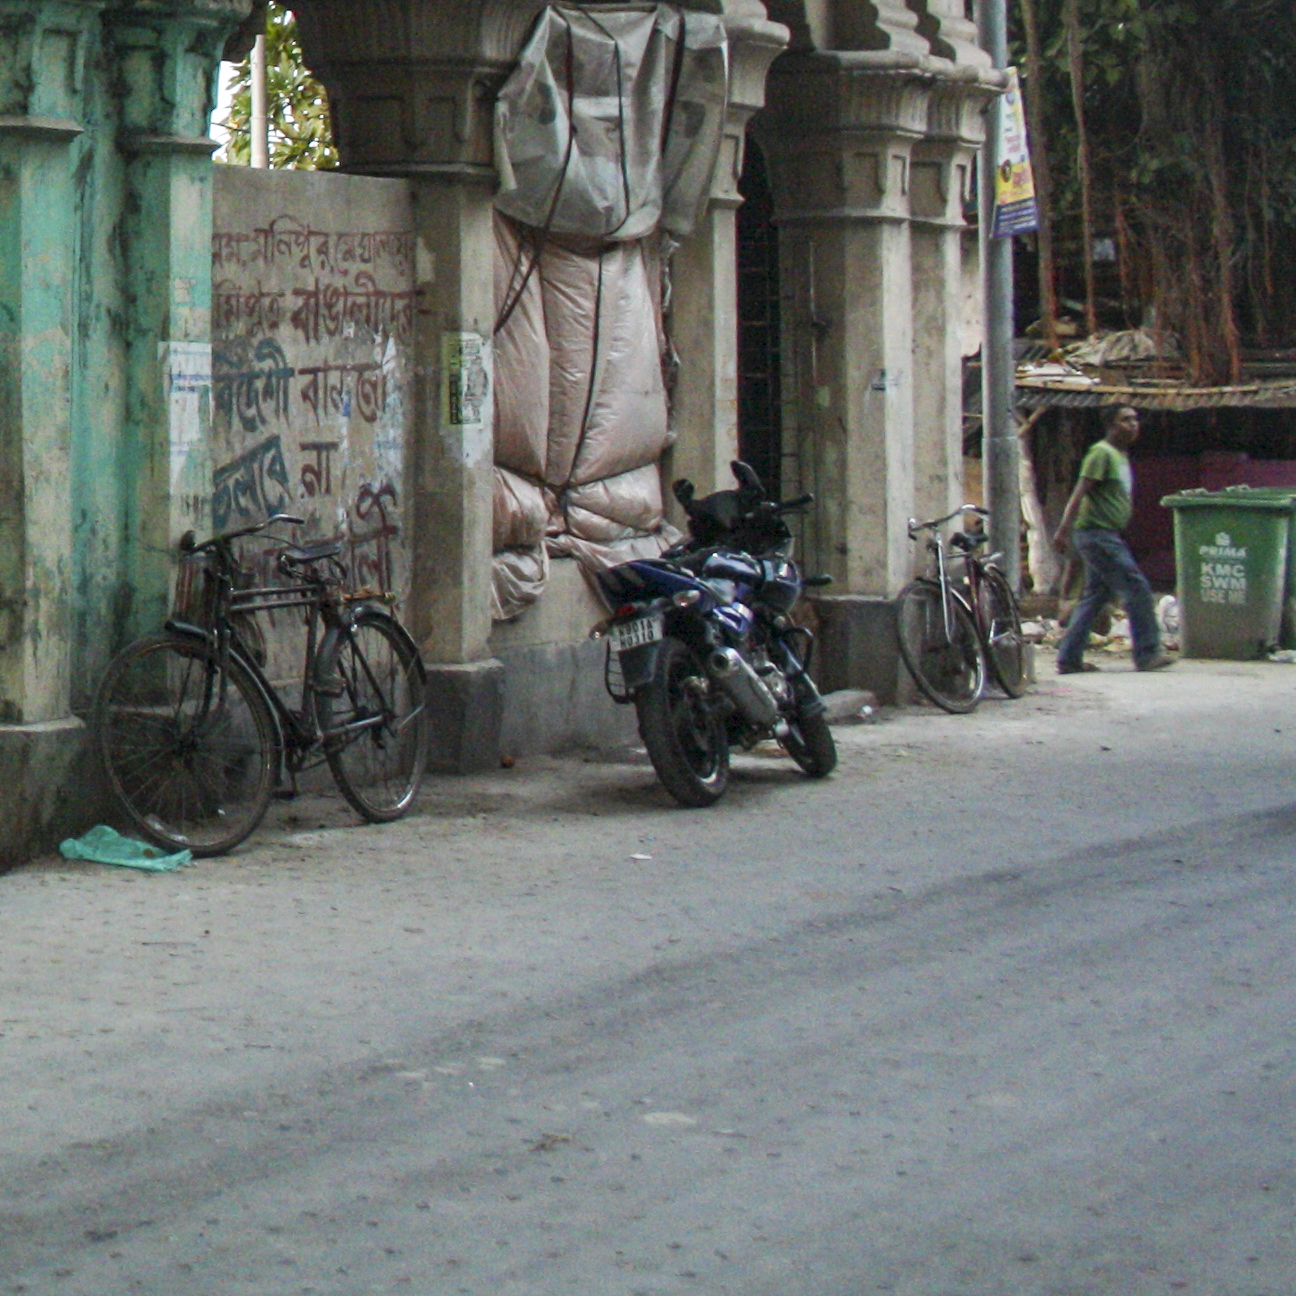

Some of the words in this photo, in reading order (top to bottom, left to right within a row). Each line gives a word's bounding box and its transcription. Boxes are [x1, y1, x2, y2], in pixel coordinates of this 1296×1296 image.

[299, 441, 340, 497] না
[1199, 545, 1246, 557] PRIMA
[1200, 563, 1245, 577] KMC
[1200, 575, 1246, 590] SWM
